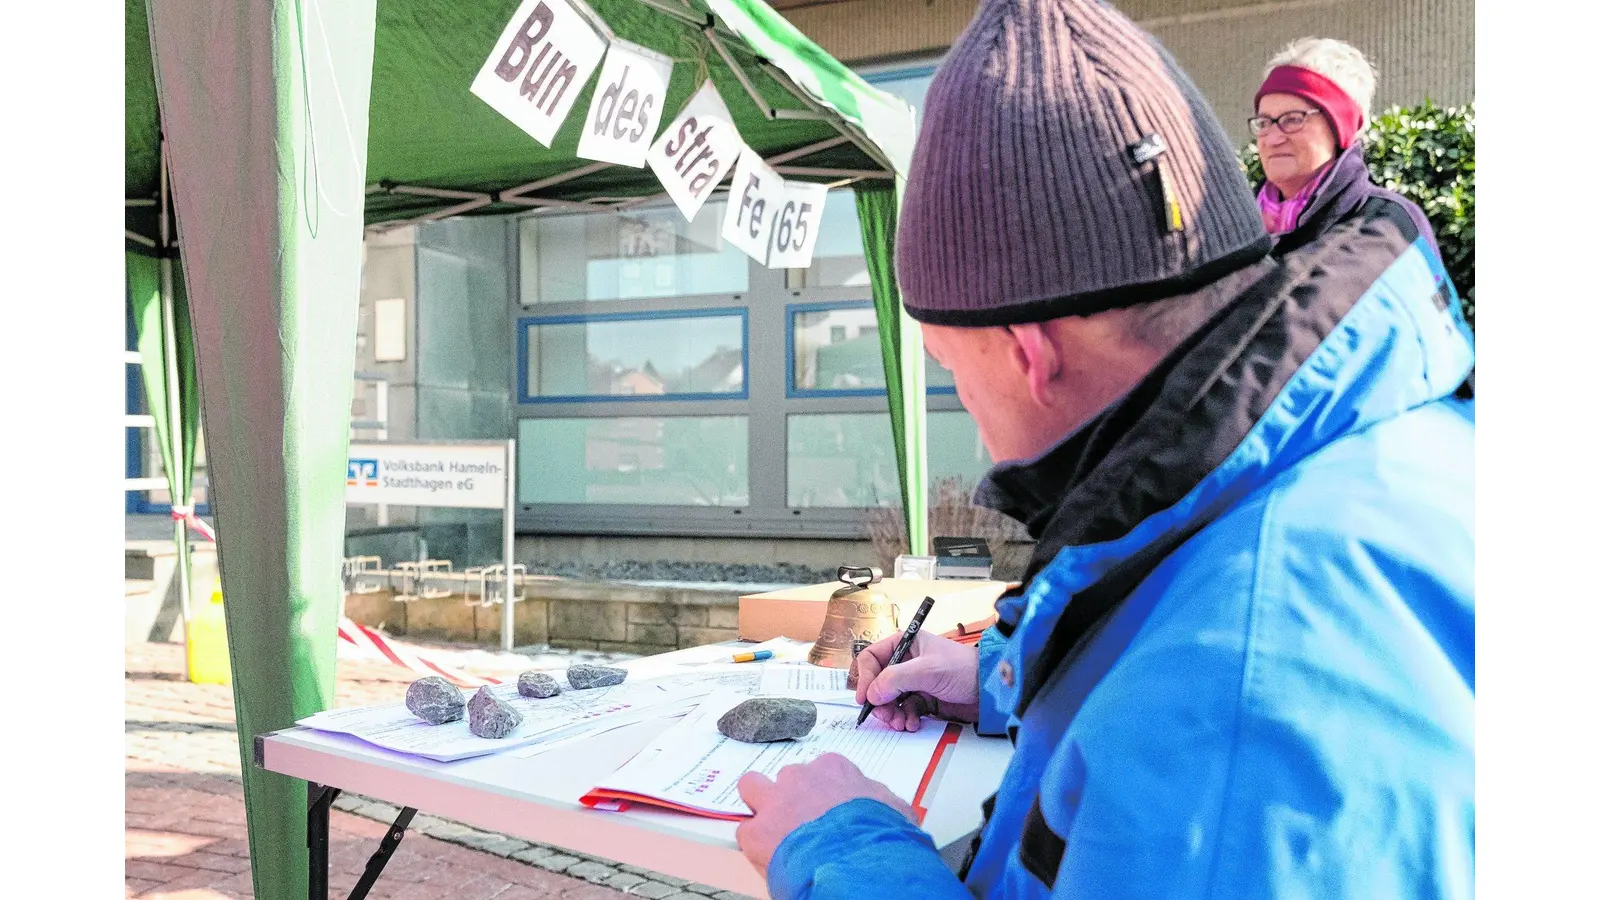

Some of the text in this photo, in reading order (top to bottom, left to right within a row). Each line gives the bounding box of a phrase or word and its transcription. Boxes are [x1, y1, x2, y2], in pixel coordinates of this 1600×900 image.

[494, 1, 578, 118] Bun
[593, 65, 654, 144] des
[665, 116, 720, 199] stra
[777, 200, 812, 253] 65
[383, 459, 503, 475] Volksbank Hameln-
[383, 476, 474, 493] Stadthagen eG
